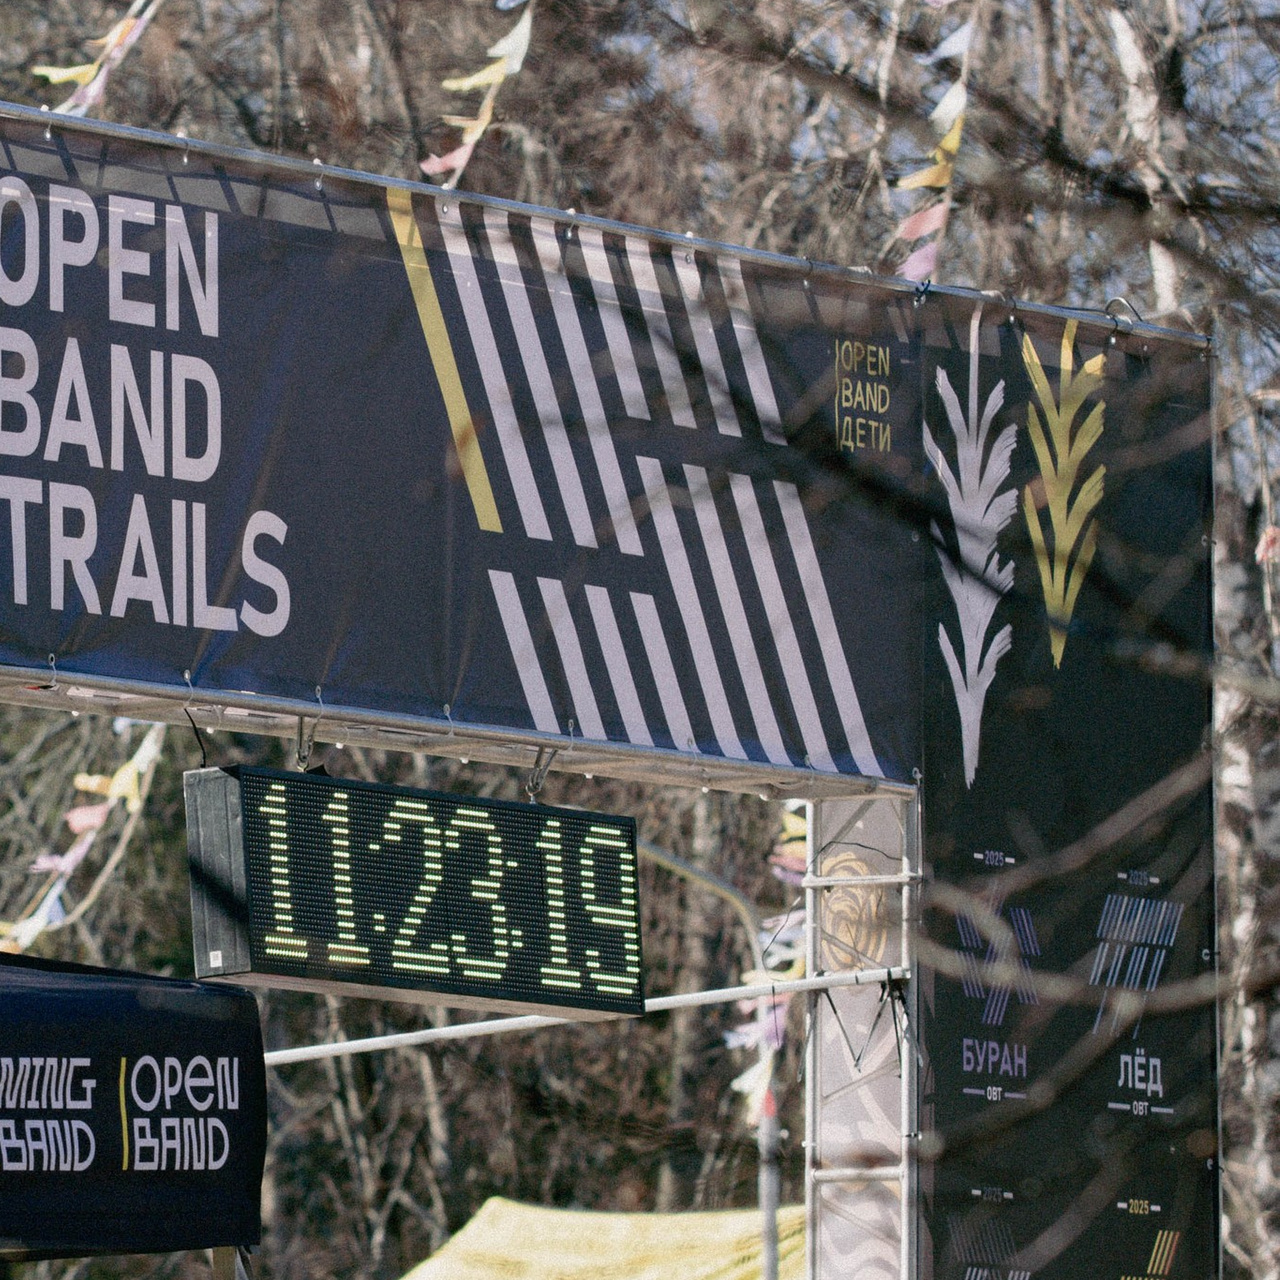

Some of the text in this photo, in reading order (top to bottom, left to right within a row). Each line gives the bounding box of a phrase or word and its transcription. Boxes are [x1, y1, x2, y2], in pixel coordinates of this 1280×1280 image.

[841, 340, 889, 376] OPEN
[841, 378, 890, 414] BAND
[840, 416, 891, 452] ДЕТИ
[985, 850, 1004, 866] 2025
[259, 784, 641, 997] 11:23:19
[962, 1038, 1027, 1077] БУРАН
[1118, 1048, 1163, 1098] ЛЁД
[133, 1118, 230, 1171] BAND
[1128, 1199, 1149, 1214] 2025
